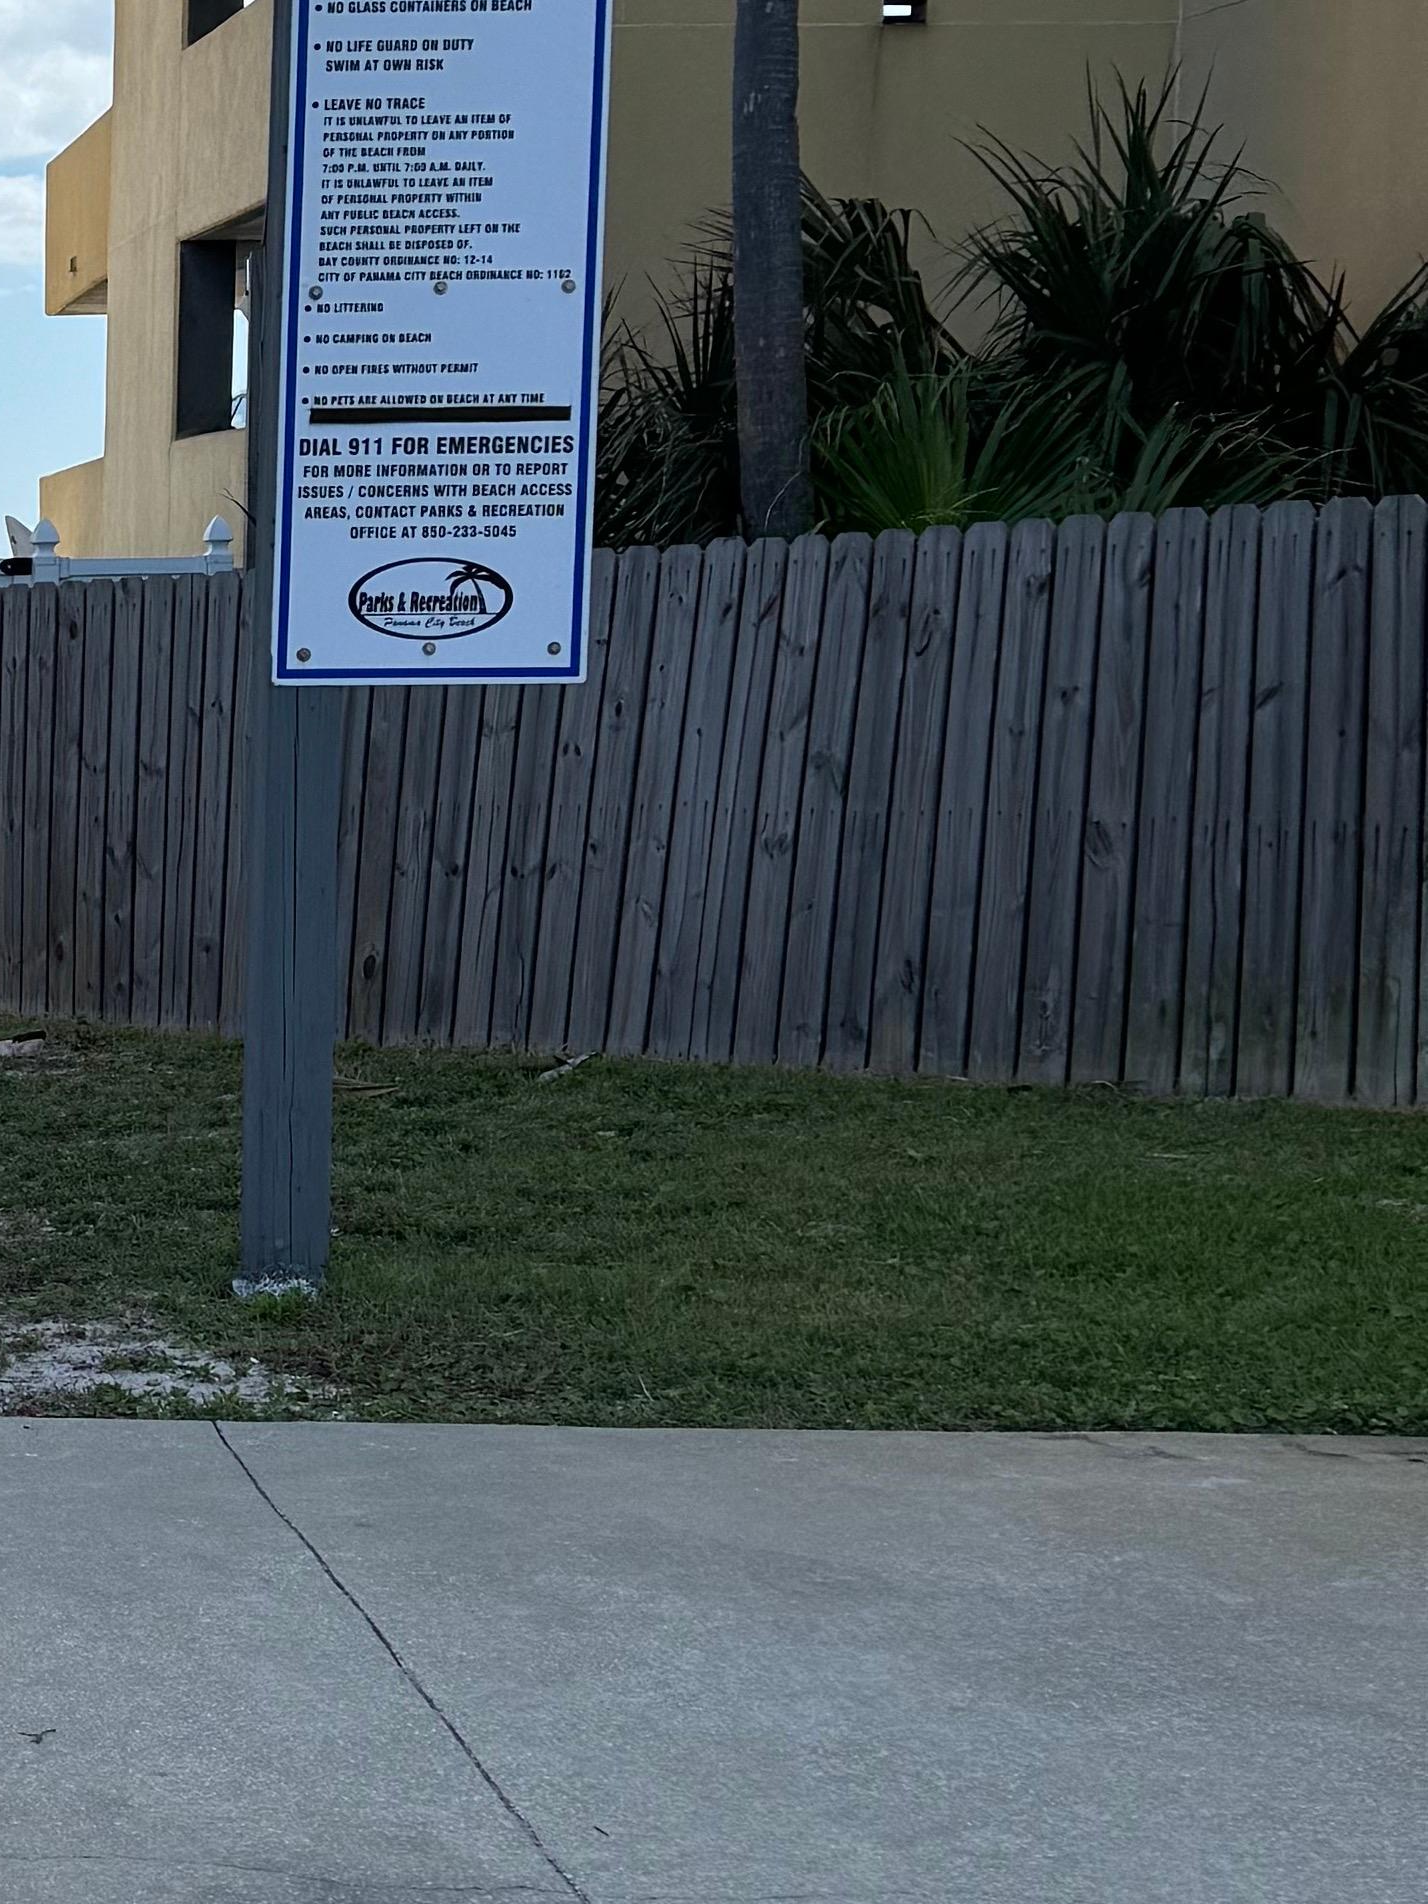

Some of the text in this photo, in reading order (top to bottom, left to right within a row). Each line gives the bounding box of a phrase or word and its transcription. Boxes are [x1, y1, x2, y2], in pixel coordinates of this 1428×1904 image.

[327, 0, 532, 14] NO GLASS CONTAINERS ON BEACH
[326, 39, 474, 52] NO LIFE GUARD ON DUTY
[325, 59, 444, 72] SWIM AT OWN RISK
[324, 98, 425, 111] LEAVE NO TRACE
[317, 303, 383, 313] NO LITTERING
[316, 333, 432, 344] NO CAMPING ON BEACH
[315, 363, 478, 374] NO OPEN FIRES WITHOUT PERMIT
[314, 394, 545, 405] NO PETS ARE ALLOWED ON BEACH AT ANY TIME
[299, 436, 573, 456] DIAL 911 FOR EMERGENCIES
[303, 463, 568, 477] FOR MORE INFORMATION OR TO REPORT
[298, 484, 572, 498] ISSUES / CONCERNS WITH BEACH ACCESS
[304, 505, 564, 518] AREAS, CONTACT PARKS & RECREATION
[350, 526, 516, 538] OFFICE AT 850-233-5045
[359, 592, 478, 612] Parks & Recreation
